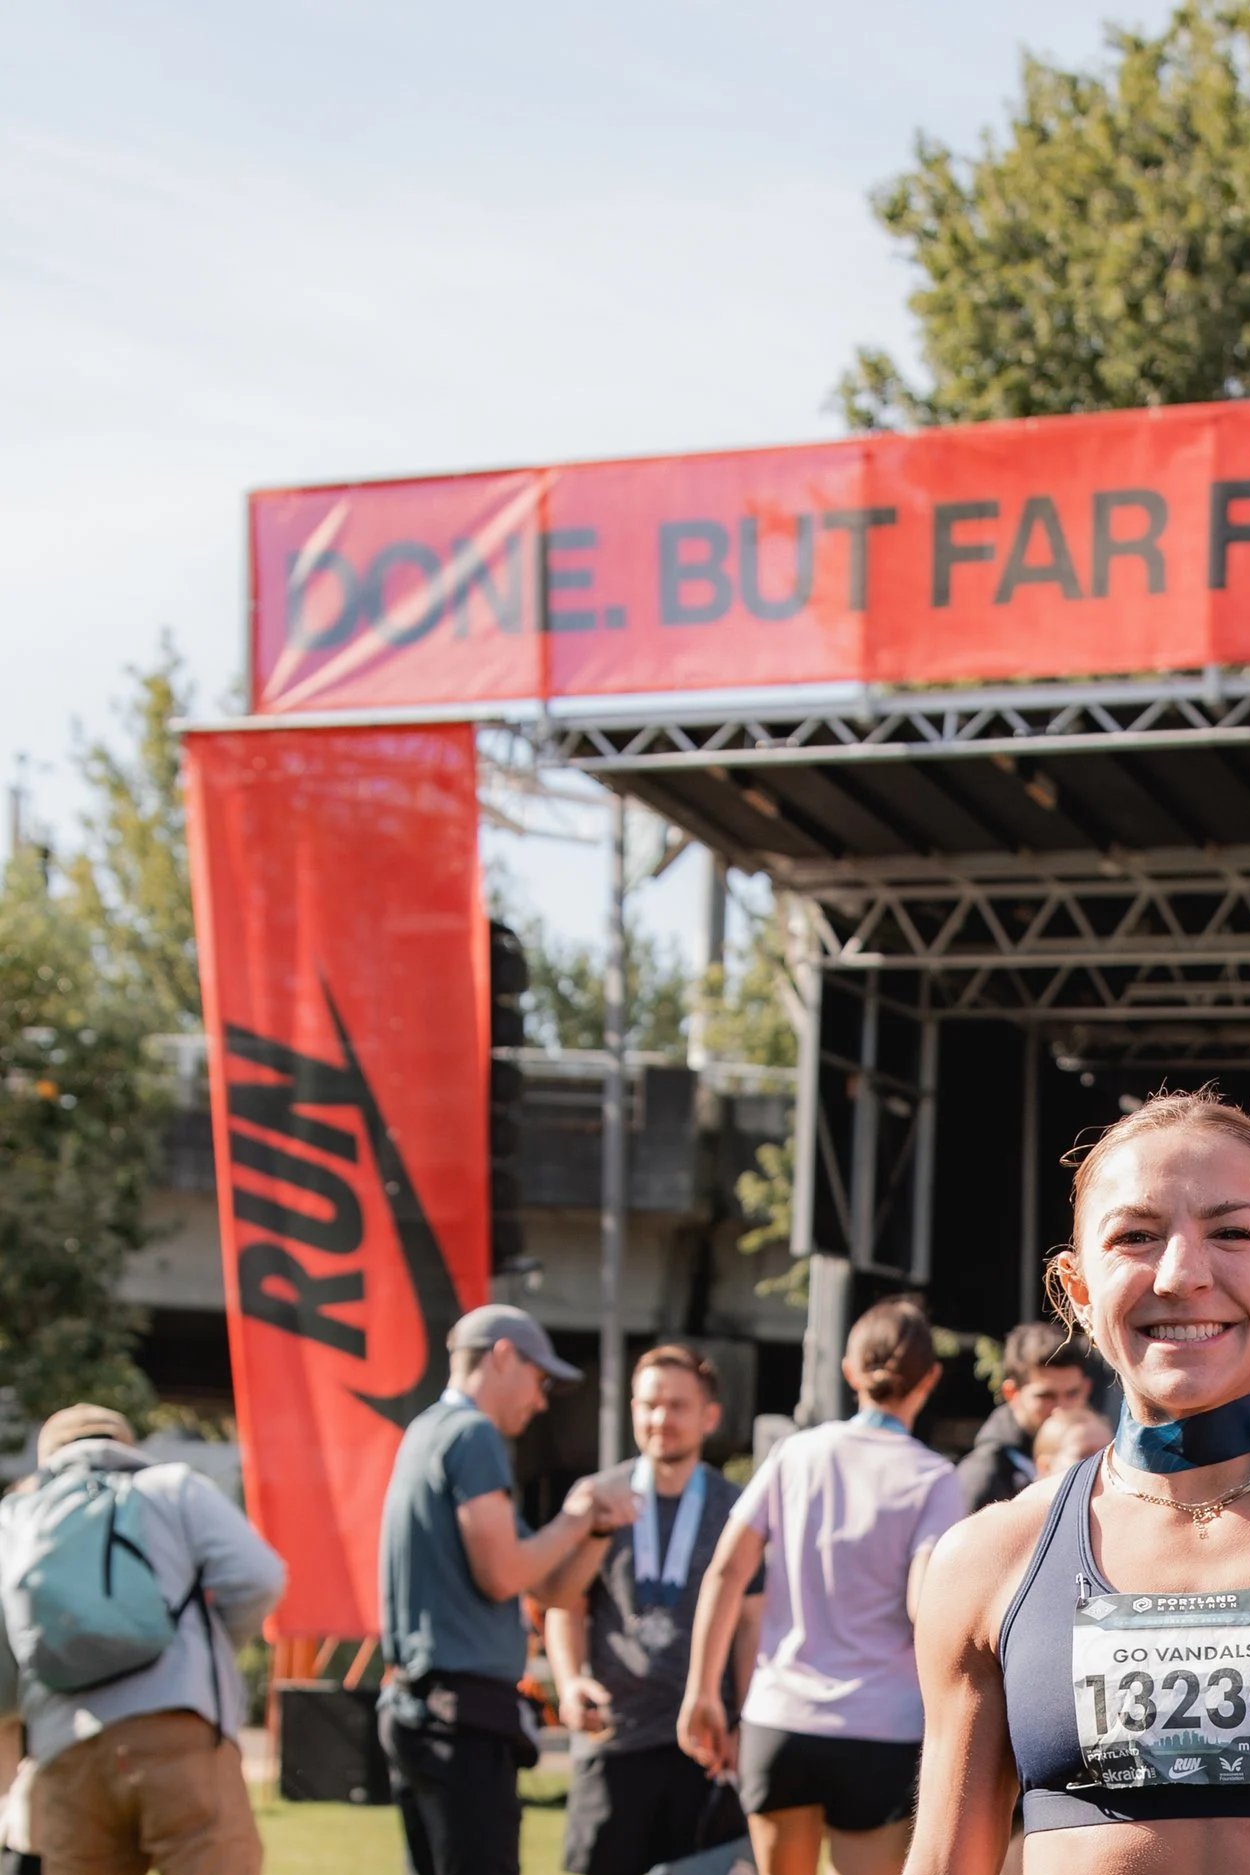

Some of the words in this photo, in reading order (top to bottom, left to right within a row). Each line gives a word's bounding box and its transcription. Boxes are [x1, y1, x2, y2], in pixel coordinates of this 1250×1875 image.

[286, 527, 626, 650] DONE.
[658, 507, 897, 627] BUT
[931, 489, 1169, 607] FAR
[224, 1022, 367, 1361] RUN
[1157, 1595, 1237, 1606] PORTLAND
[1157, 1602, 1237, 1611] MARATHON
[1113, 1648, 1148, 1663] GO
[1174, 1758, 1201, 1771] RUN
